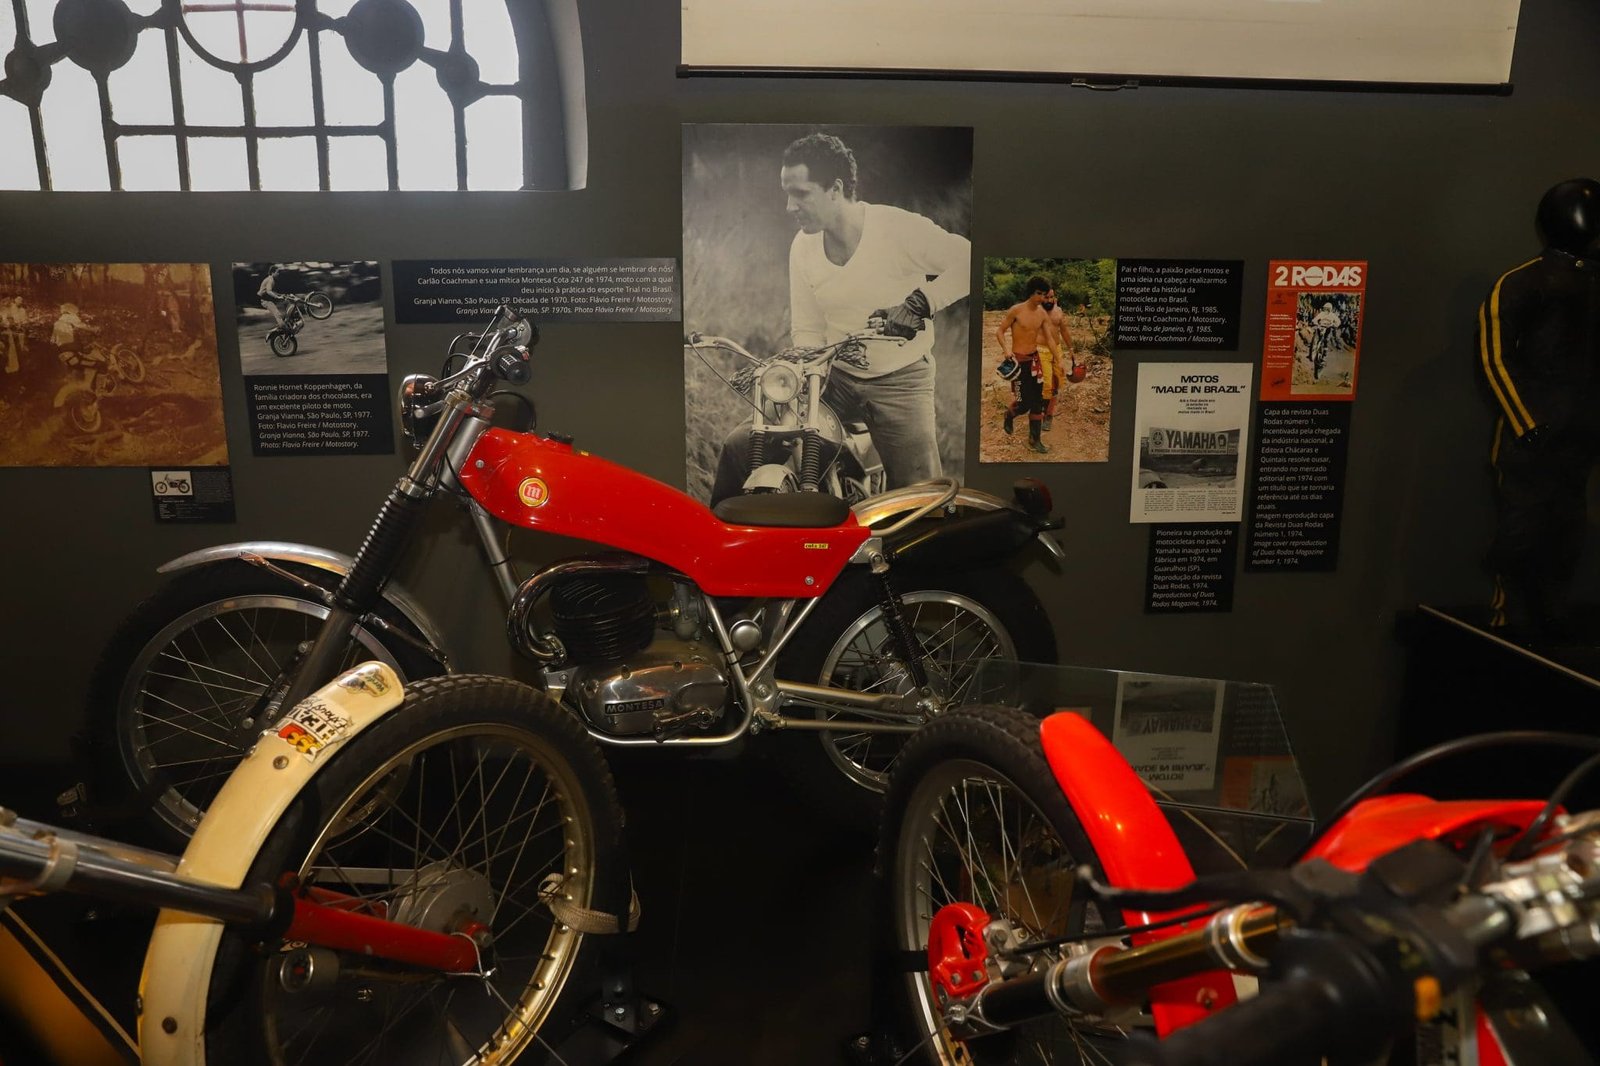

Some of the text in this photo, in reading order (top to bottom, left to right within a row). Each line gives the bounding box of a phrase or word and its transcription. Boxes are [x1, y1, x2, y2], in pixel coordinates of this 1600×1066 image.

[508, 267, 544, 275] lembrança
[1274, 266, 1362, 287] 2 RODAS
[414, 298, 436, 306] Granja
[456, 308, 478, 316] Granja
[1204, 385, 1246, 393] BRAZIL"
[1166, 429, 1216, 449] YAMAHA
[606, 700, 662, 713] MONTESA
